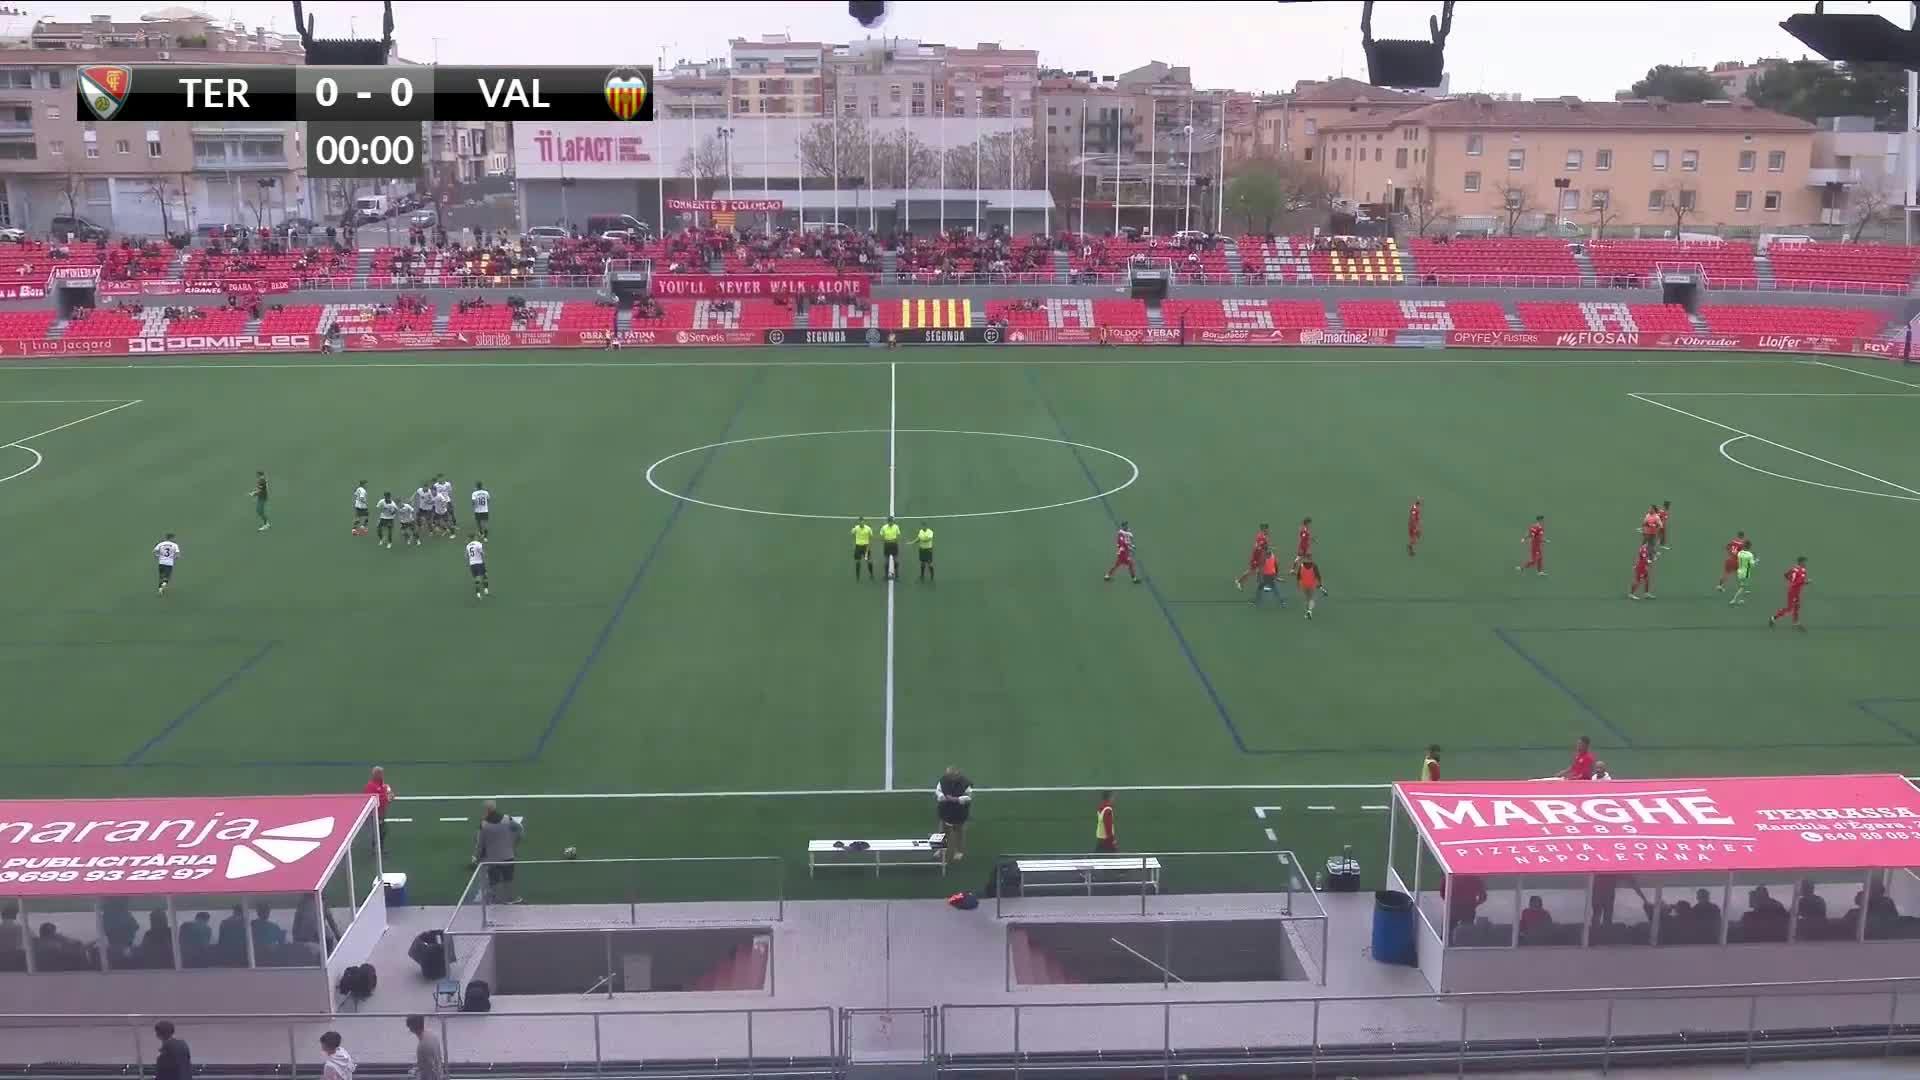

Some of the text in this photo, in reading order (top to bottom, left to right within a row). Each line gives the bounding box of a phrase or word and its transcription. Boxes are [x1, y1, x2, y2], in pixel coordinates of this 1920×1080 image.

[659, 280, 706, 294] YOU'LL
[817, 279, 861, 293] ALONE
[806, 331, 846, 343] SEGUNDA
[925, 330, 965, 342] SEGUNDA
[1578, 332, 1639, 345] FIOSAN
[1417, 796, 1736, 831] MARGHE
[1756, 807, 1920, 821] TERRASSA
[0, 811, 259, 848] naranja
[1540, 825, 1638, 835] 1889
[1456, 842, 1754, 858] PIZZERIA GOURMET
[1515, 853, 1713, 865] NAPOLETANA
[18, 867, 214, 882] 699 93 22 97
